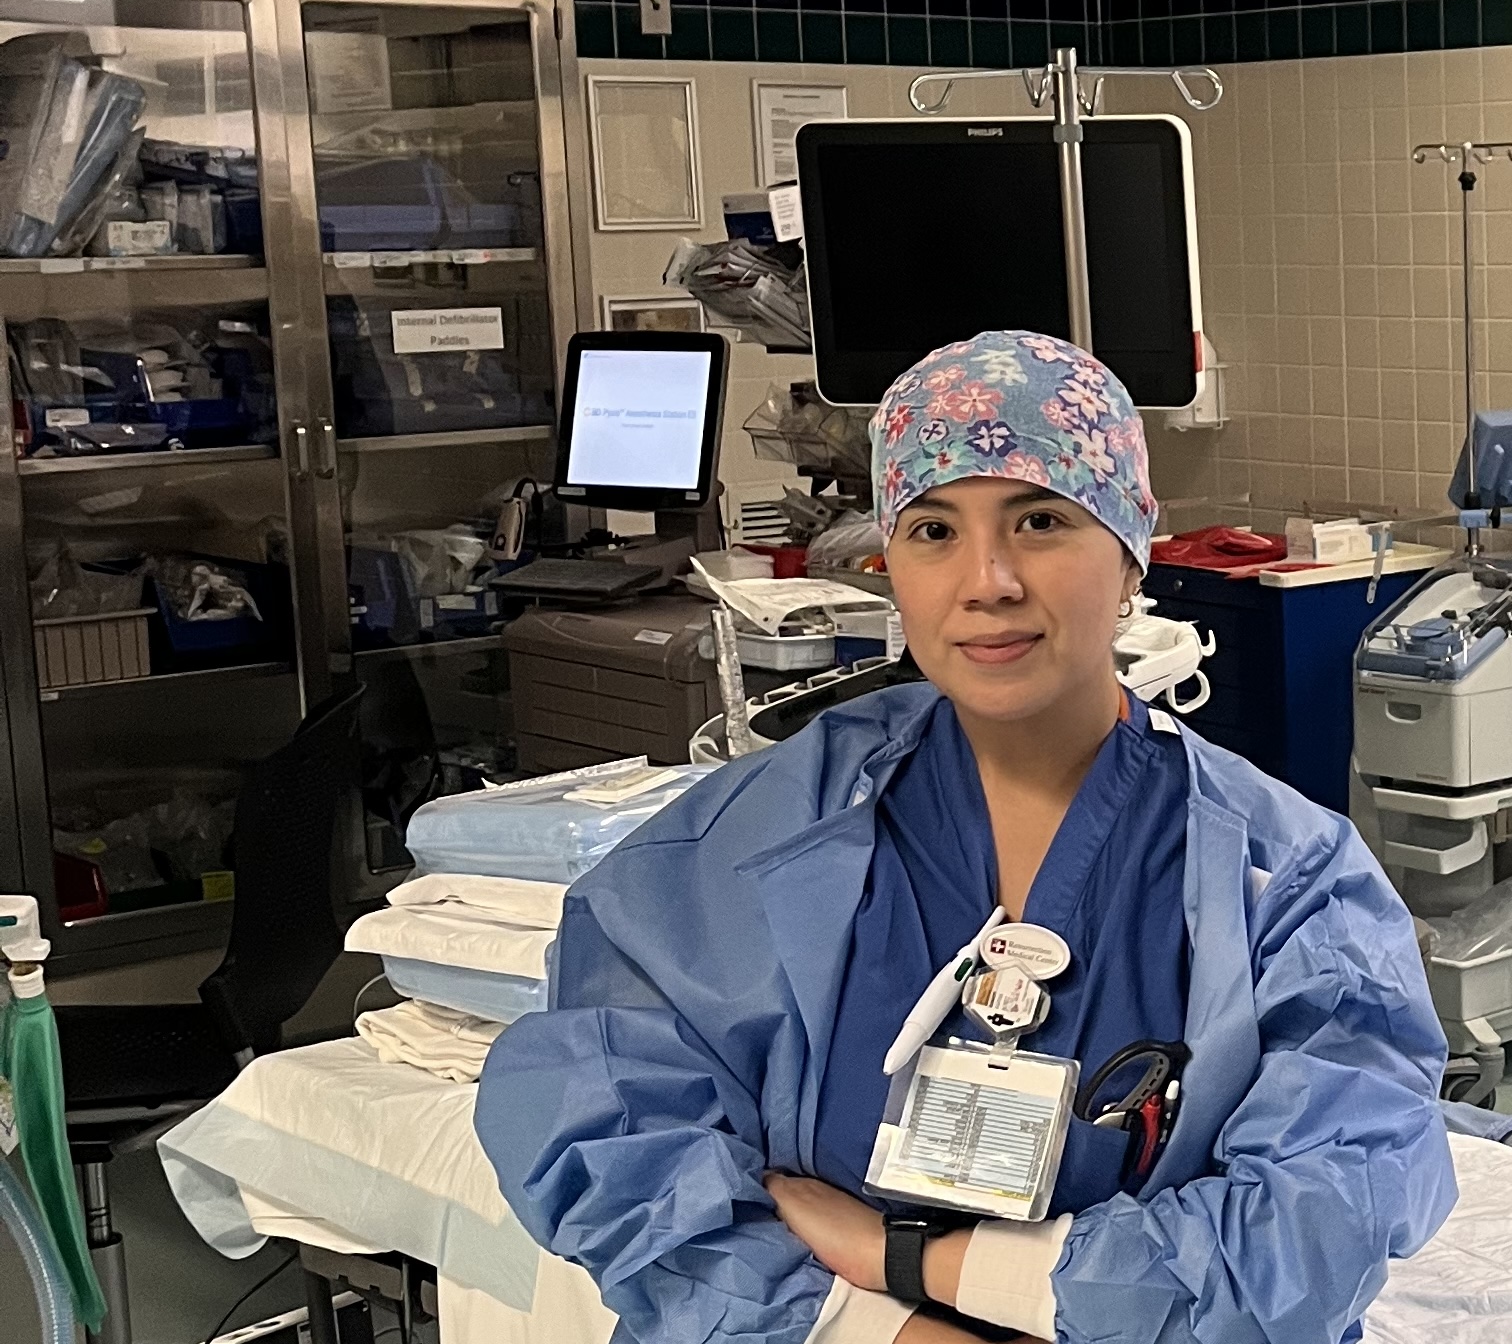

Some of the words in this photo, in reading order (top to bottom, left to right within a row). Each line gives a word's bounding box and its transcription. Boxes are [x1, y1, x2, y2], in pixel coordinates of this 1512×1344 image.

[968, 127, 1003, 136] PHILIPS
[397, 314, 437, 326] Internal
[439, 313, 498, 325] Defibrillator
[430, 335, 470, 346] Paddles
[1007, 950, 1034, 960] Medical
[1035, 955, 1059, 965] Center
